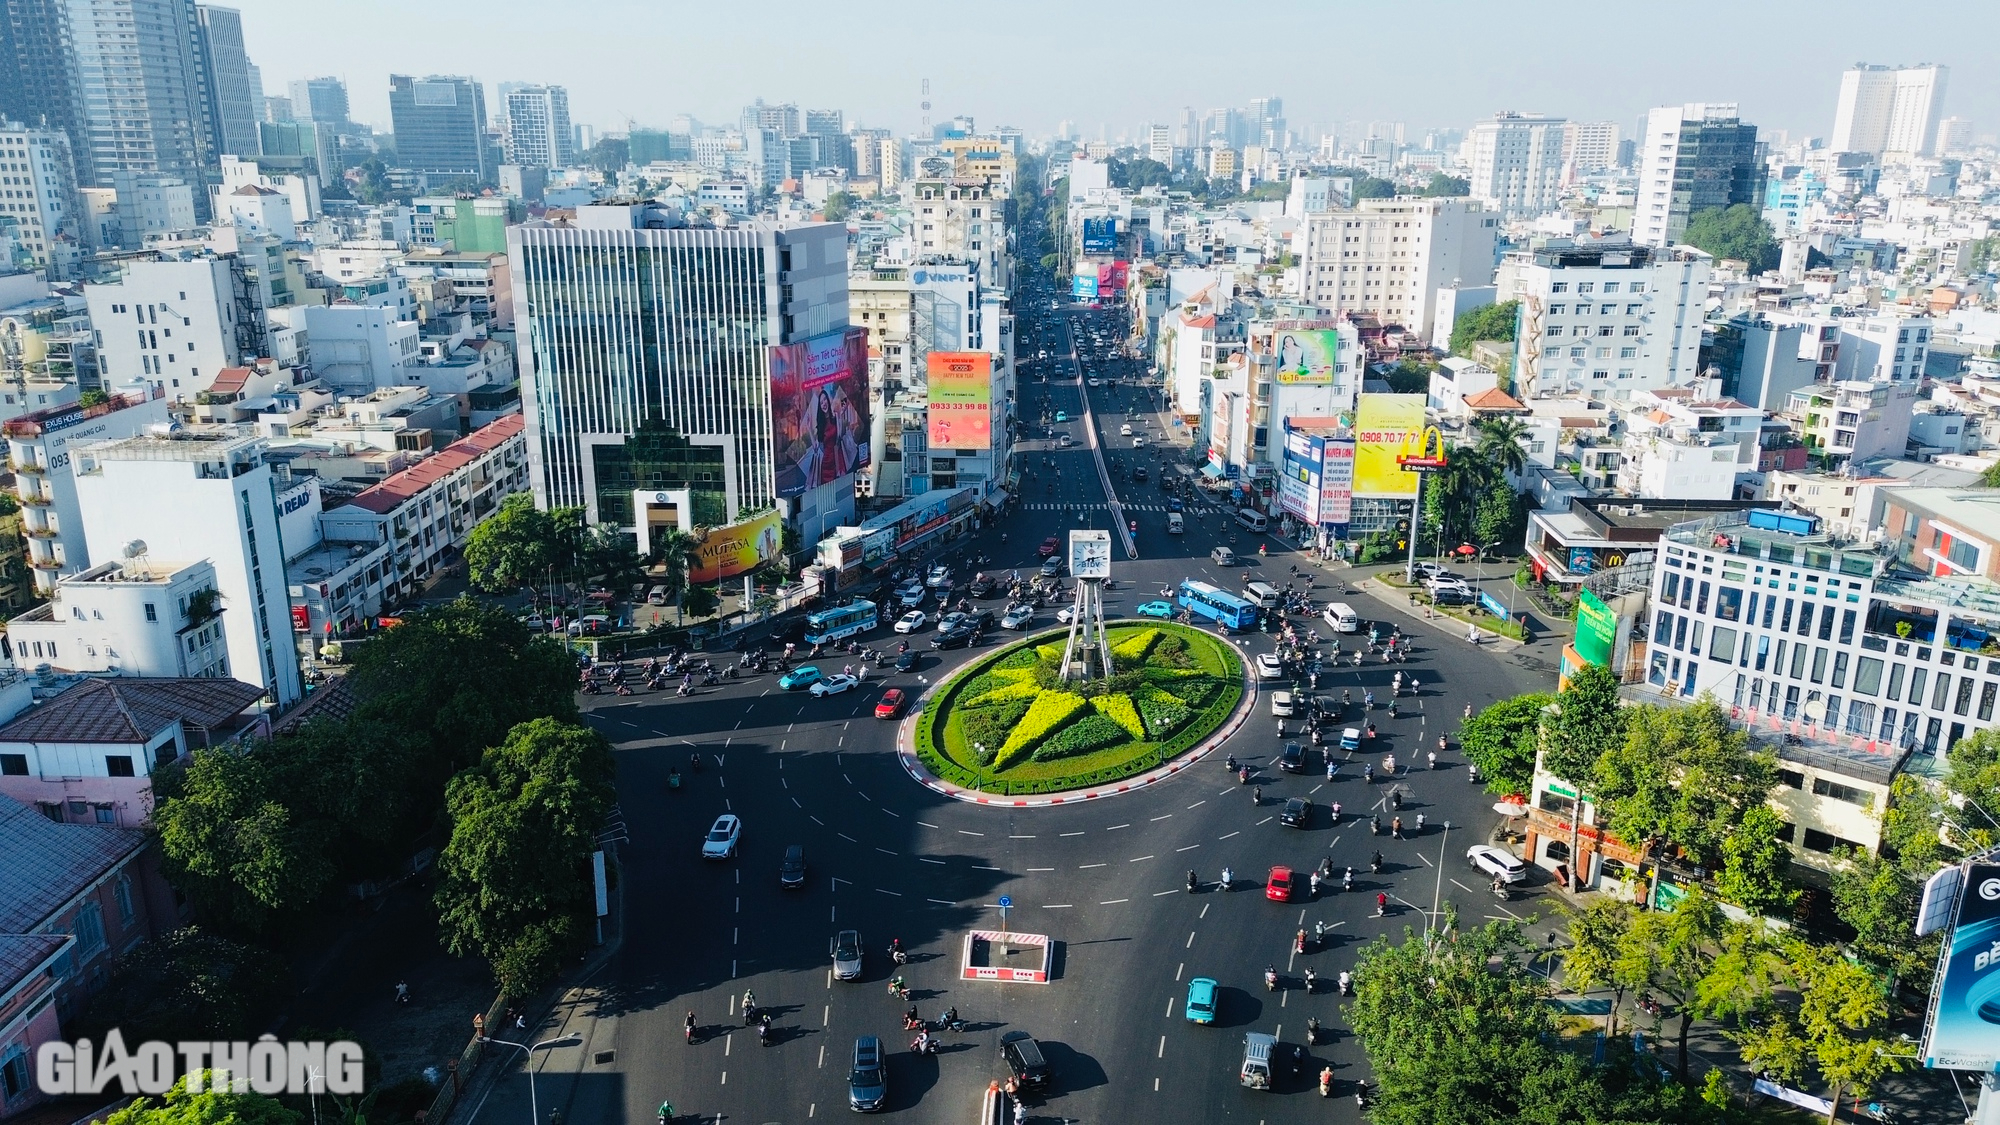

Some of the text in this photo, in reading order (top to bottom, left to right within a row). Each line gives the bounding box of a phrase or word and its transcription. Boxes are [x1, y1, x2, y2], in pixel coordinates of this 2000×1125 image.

[927, 273, 967, 282] VNPT
[284, 492, 310, 514] READ
[702, 538, 750, 558] MUFASA
